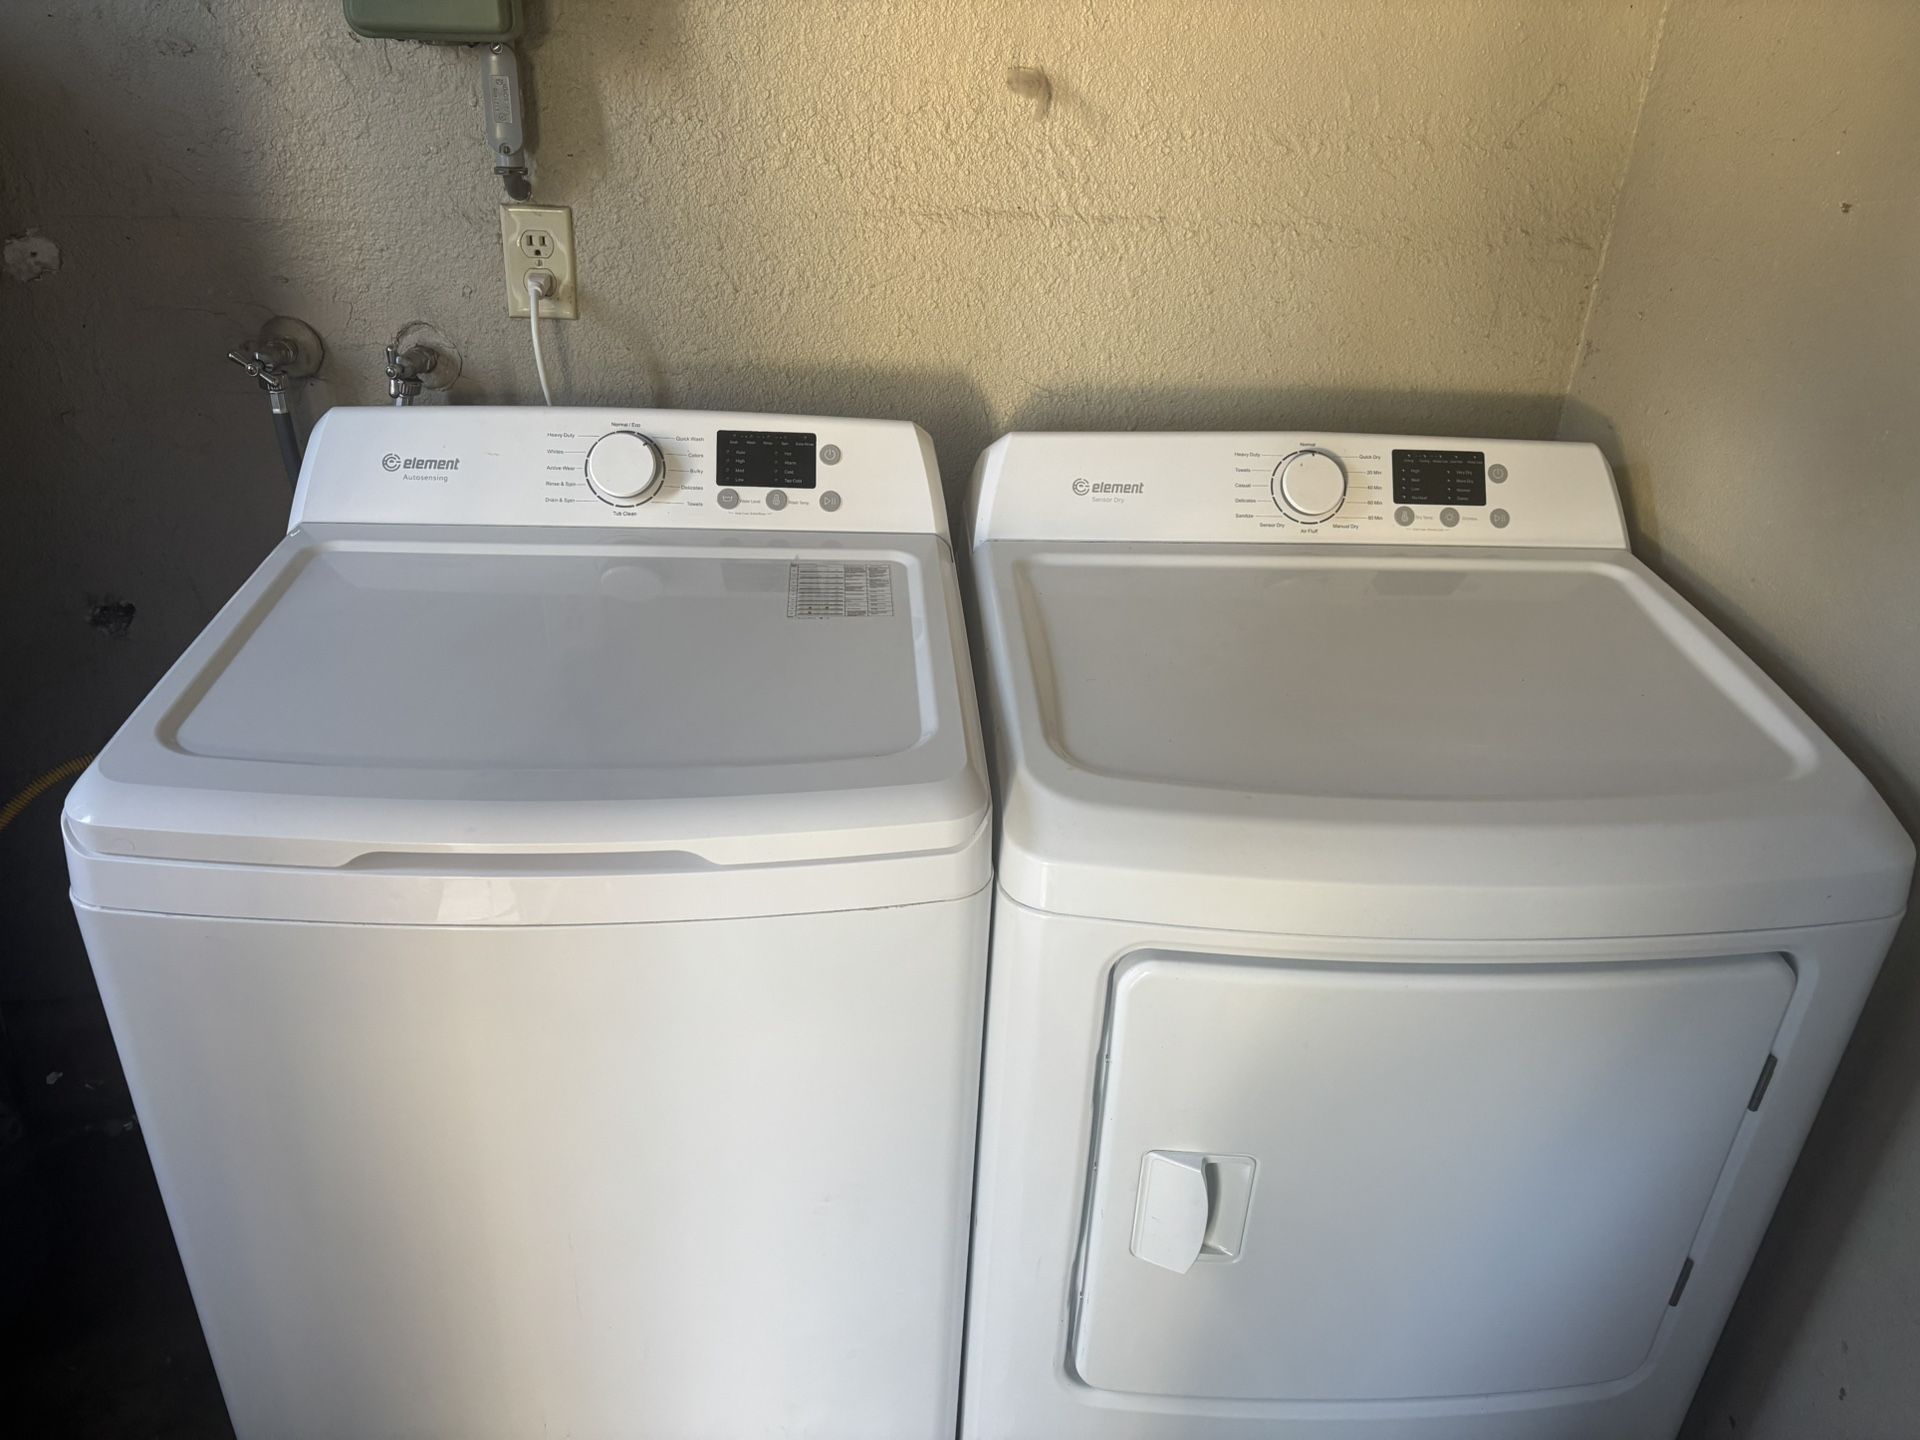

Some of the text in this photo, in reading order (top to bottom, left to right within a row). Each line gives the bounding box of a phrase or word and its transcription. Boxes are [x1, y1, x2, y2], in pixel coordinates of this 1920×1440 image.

[403, 457, 460, 470] element
[403, 474, 448, 482] Autosensing
[1092, 482, 1144, 494] element
